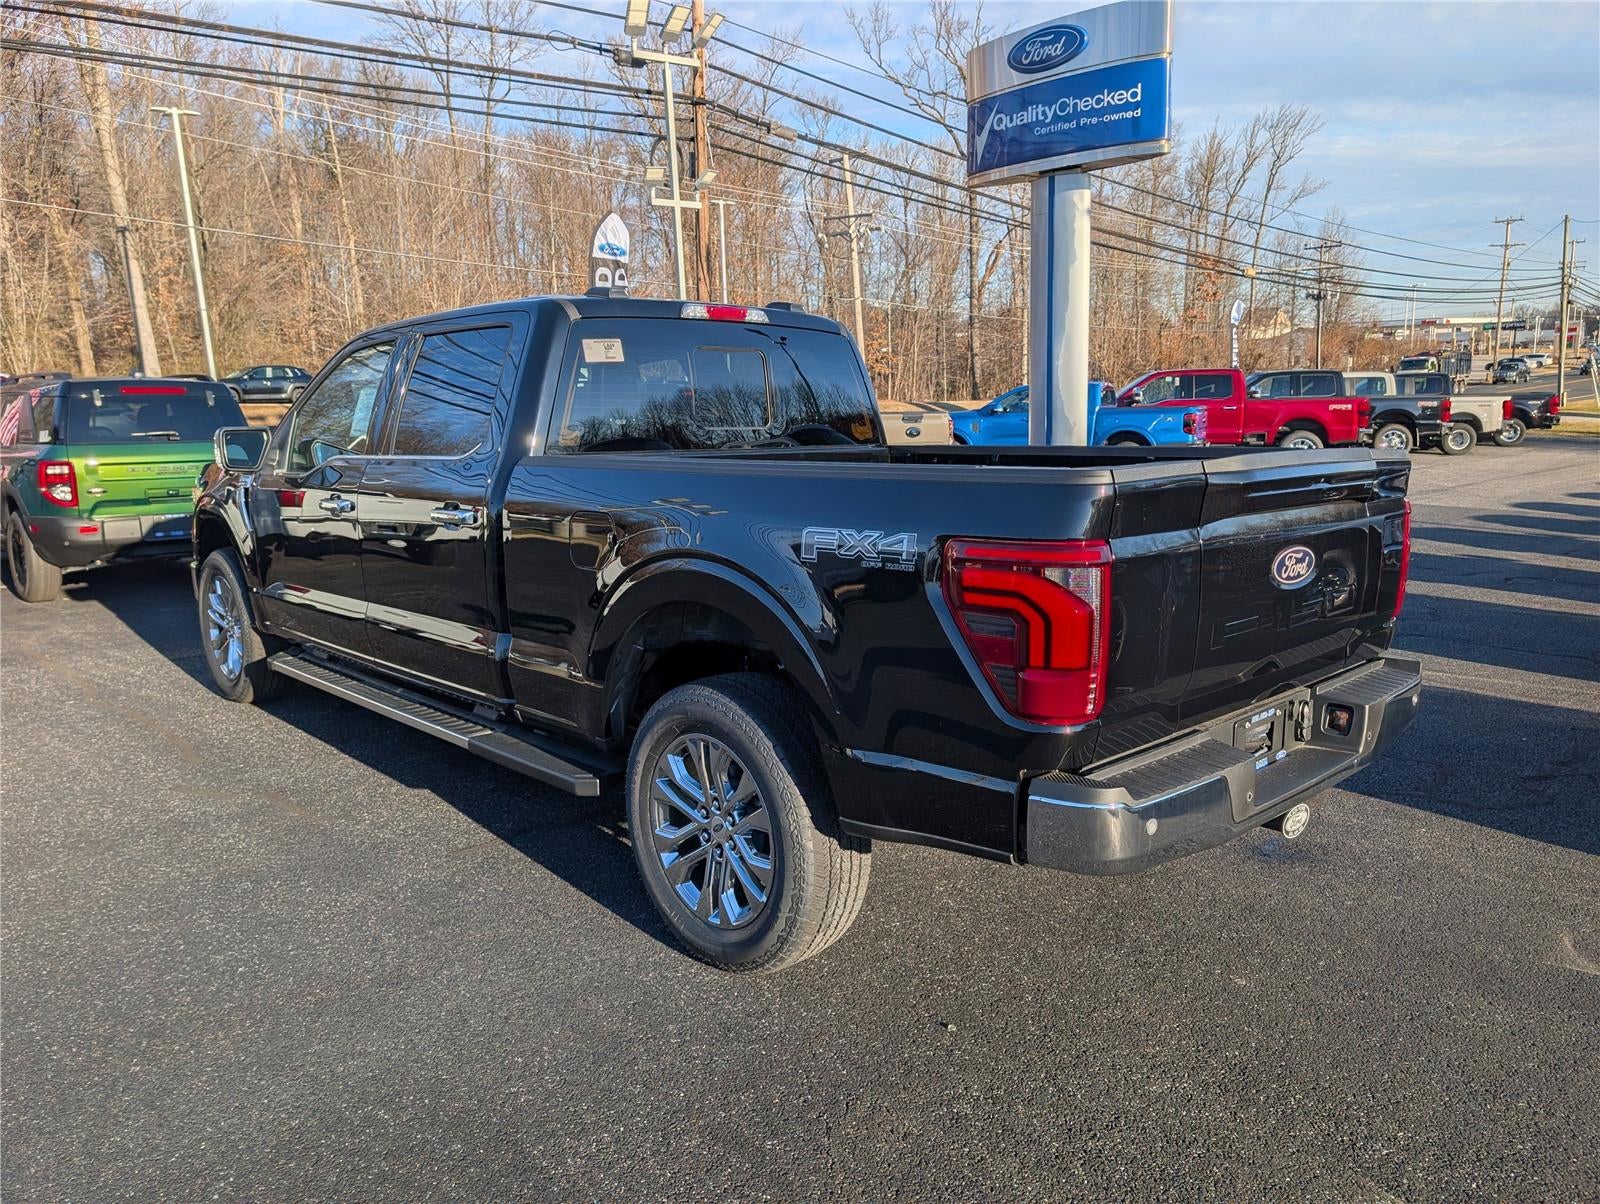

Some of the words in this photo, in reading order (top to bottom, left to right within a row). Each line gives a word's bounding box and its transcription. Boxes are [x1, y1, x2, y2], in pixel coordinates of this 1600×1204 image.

[1022, 33, 1066, 64] Ford
[993, 83, 1142, 131] QualityChecked
[1034, 119, 1077, 136] Certified
[1080, 108, 1142, 126] Pre-owned
[801, 526, 918, 564] FX4
[1281, 552, 1309, 579] Ford
